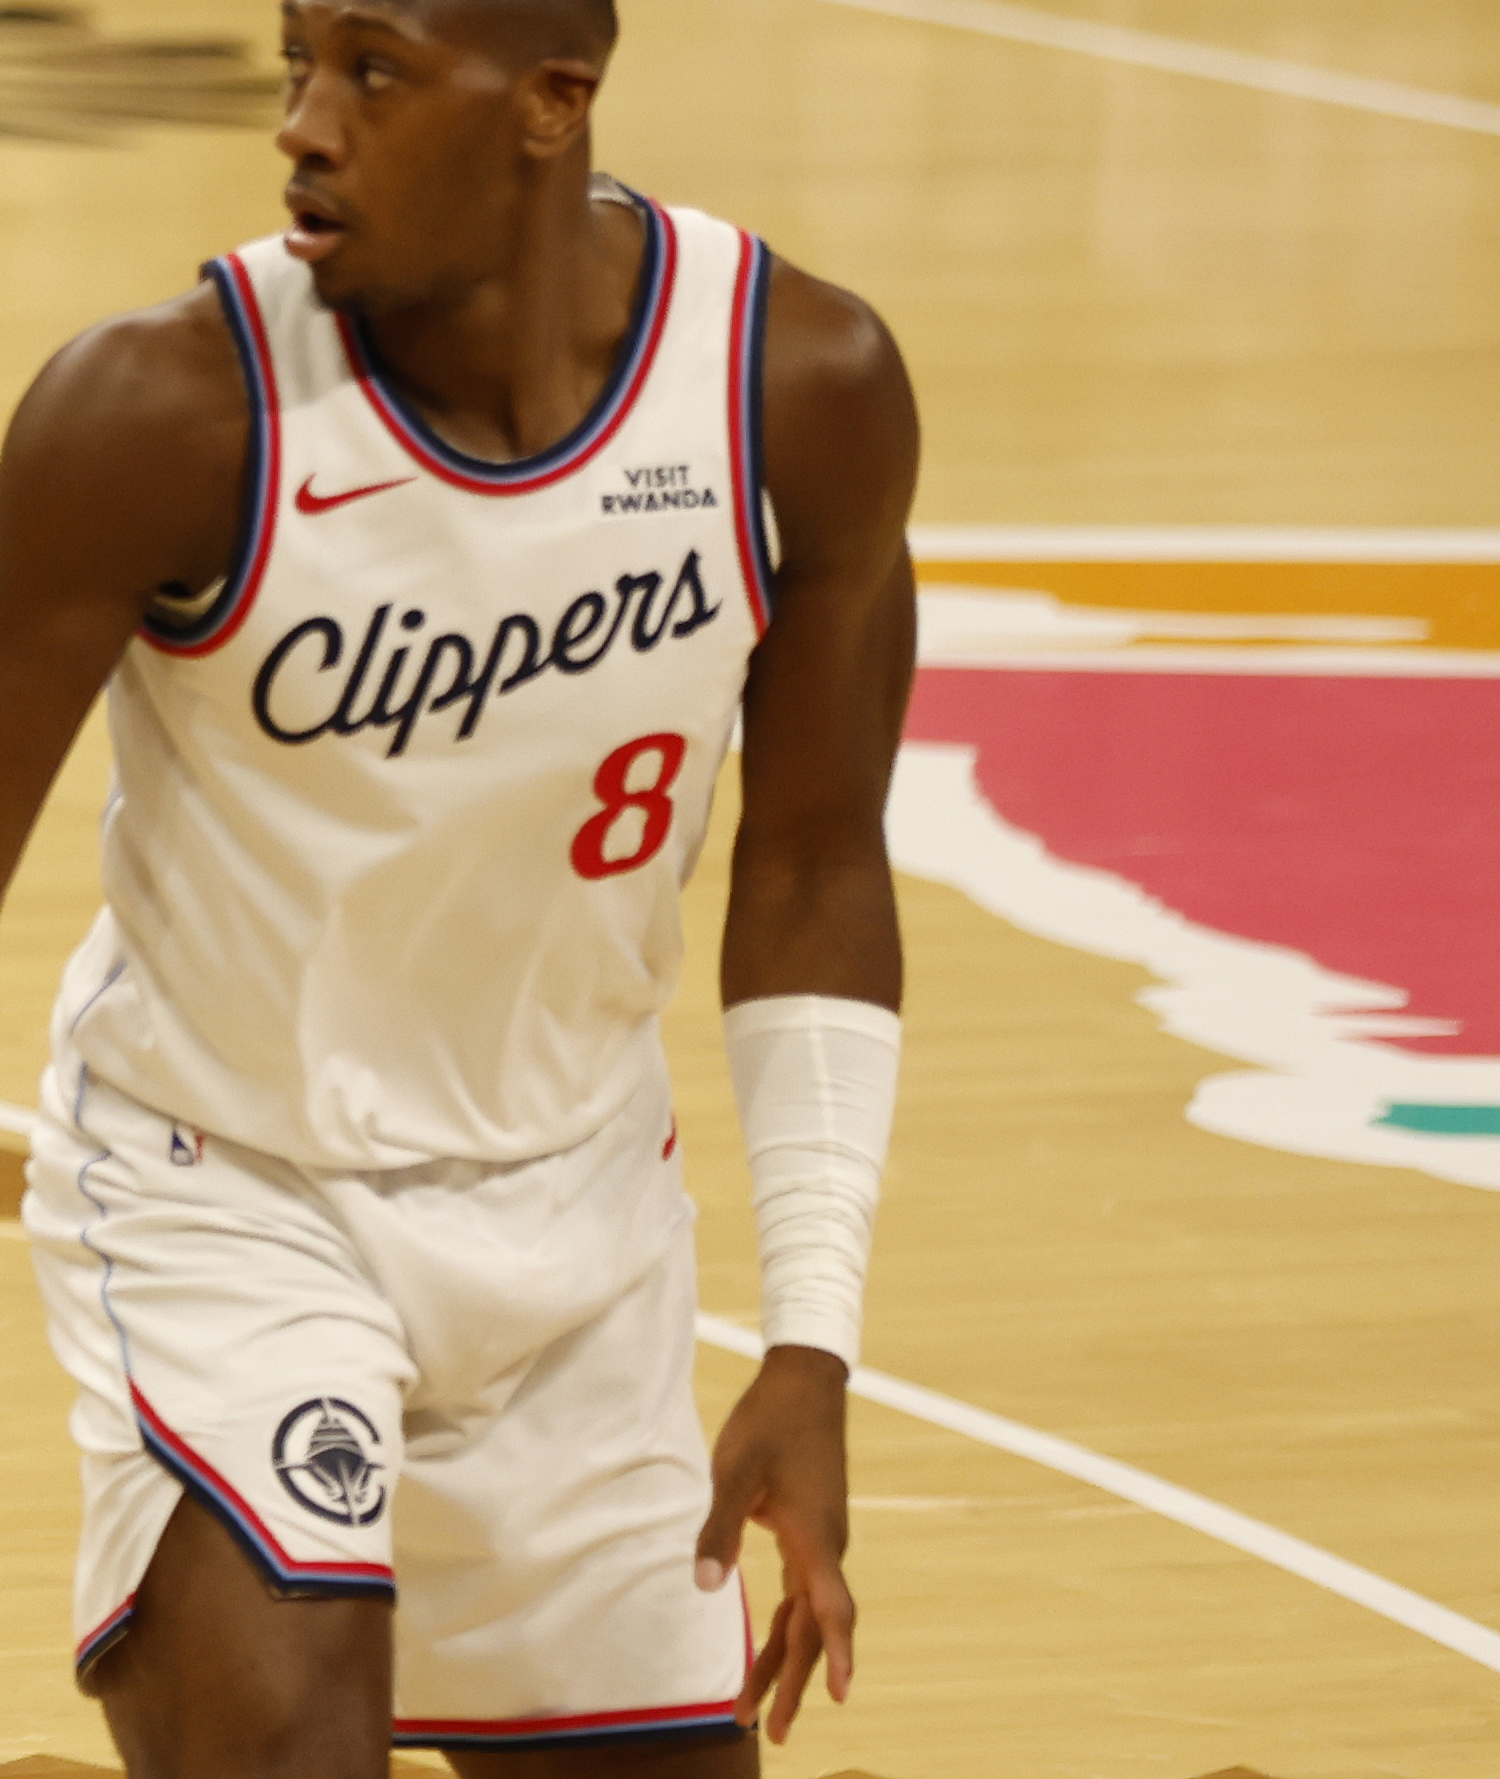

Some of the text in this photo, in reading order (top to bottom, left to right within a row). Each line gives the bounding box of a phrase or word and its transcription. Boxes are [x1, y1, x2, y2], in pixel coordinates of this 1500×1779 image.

[601, 486, 718, 514] RWANDA
[624, 464, 690, 488] VISIT
[251, 549, 722, 759] Clippers
[570, 732, 687, 881] 8
